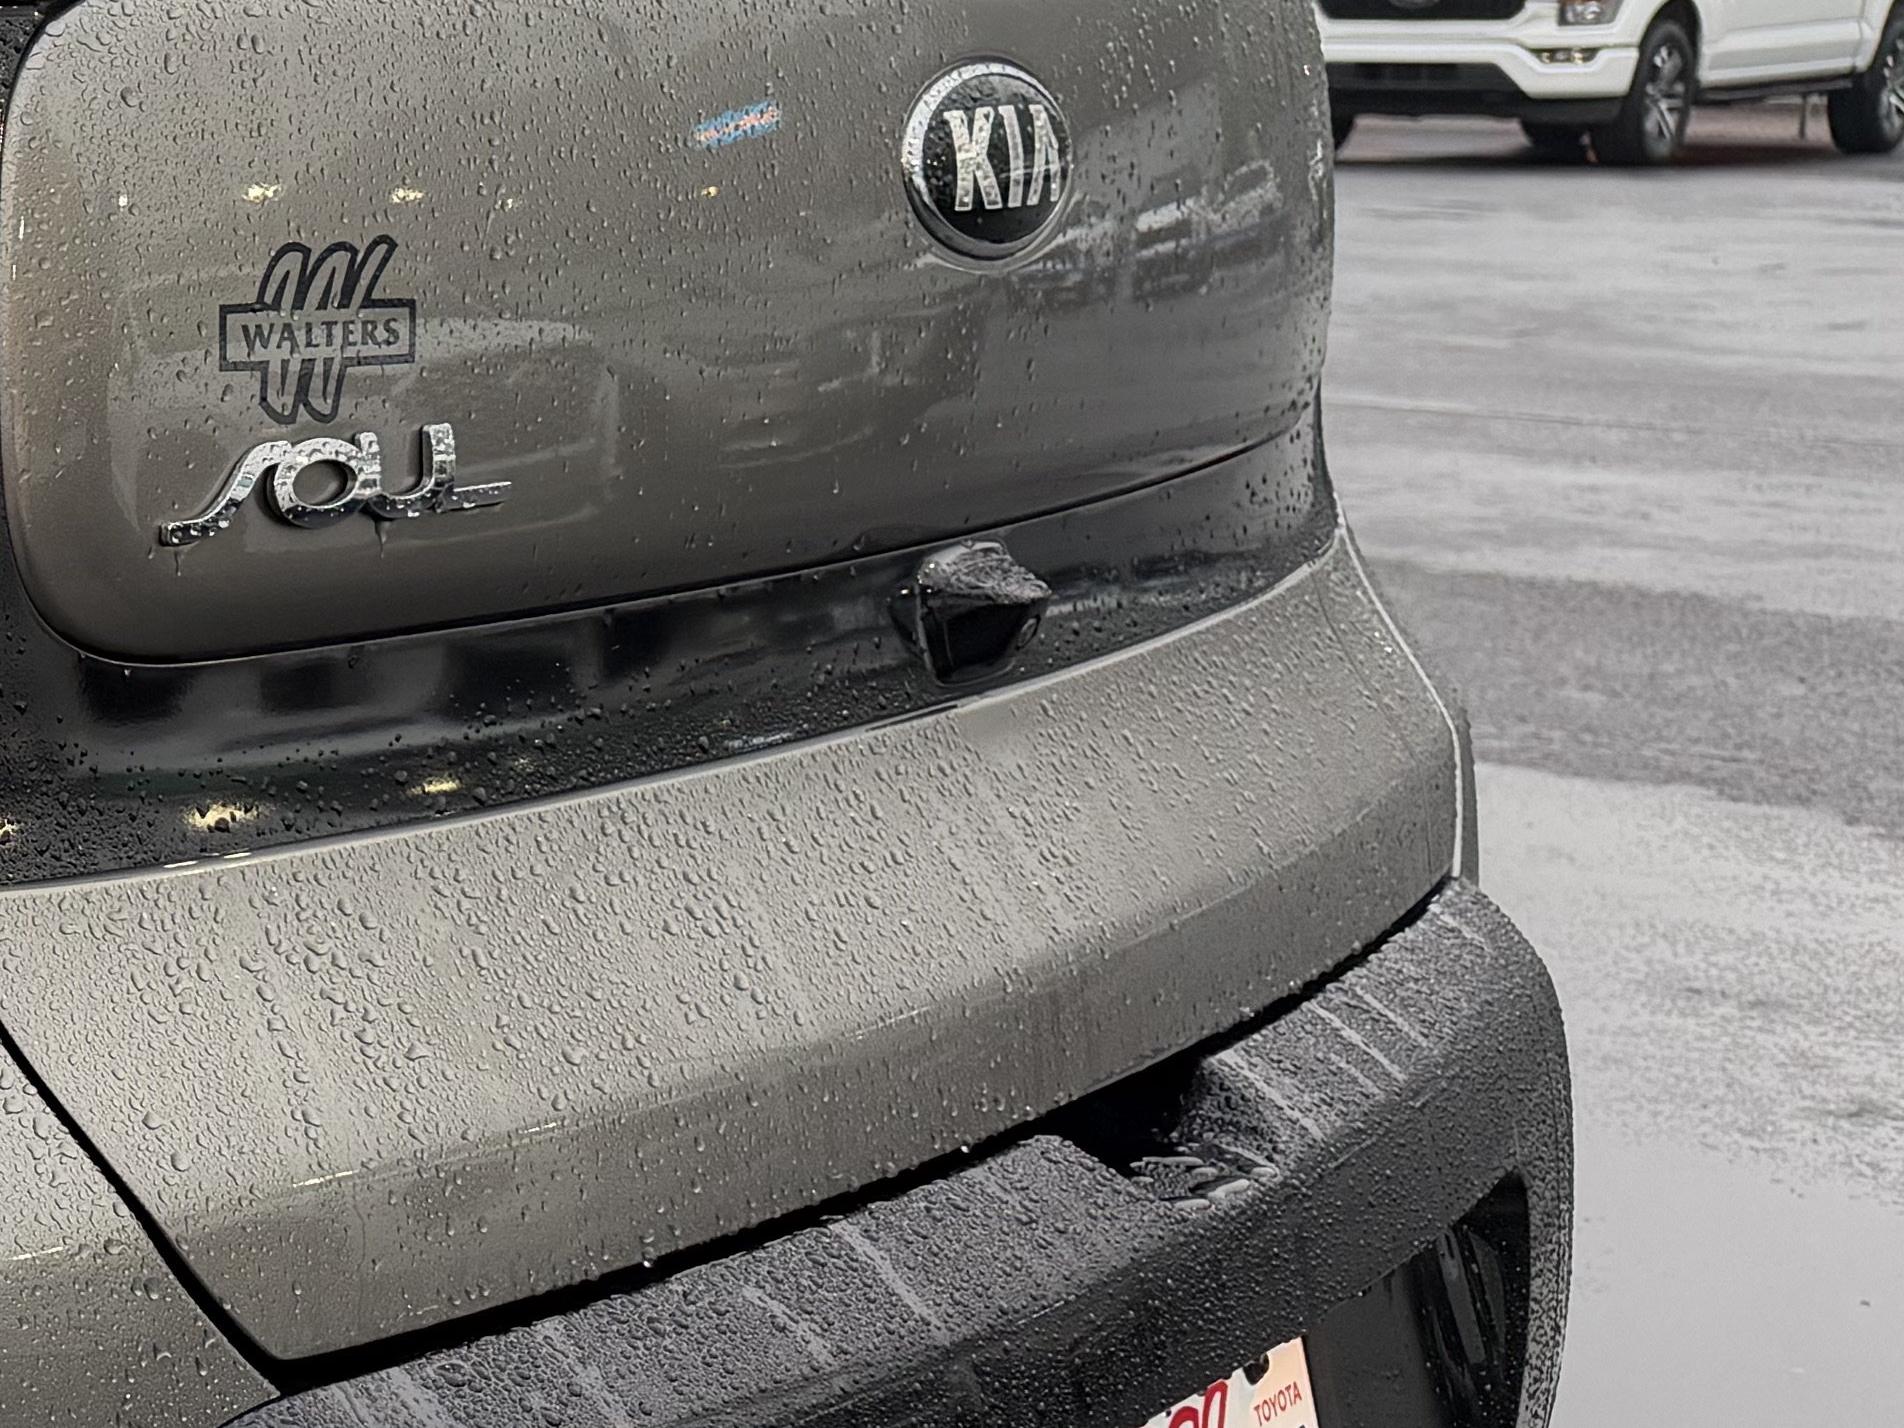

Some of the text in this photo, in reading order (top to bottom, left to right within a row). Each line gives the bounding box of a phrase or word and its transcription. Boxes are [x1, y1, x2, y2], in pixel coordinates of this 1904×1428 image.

[943, 103, 1062, 212] KIA
[241, 312, 400, 352] WALTERS
[158, 422, 513, 546] SOUL
[1253, 1380, 1302, 1426] TOYOTA
